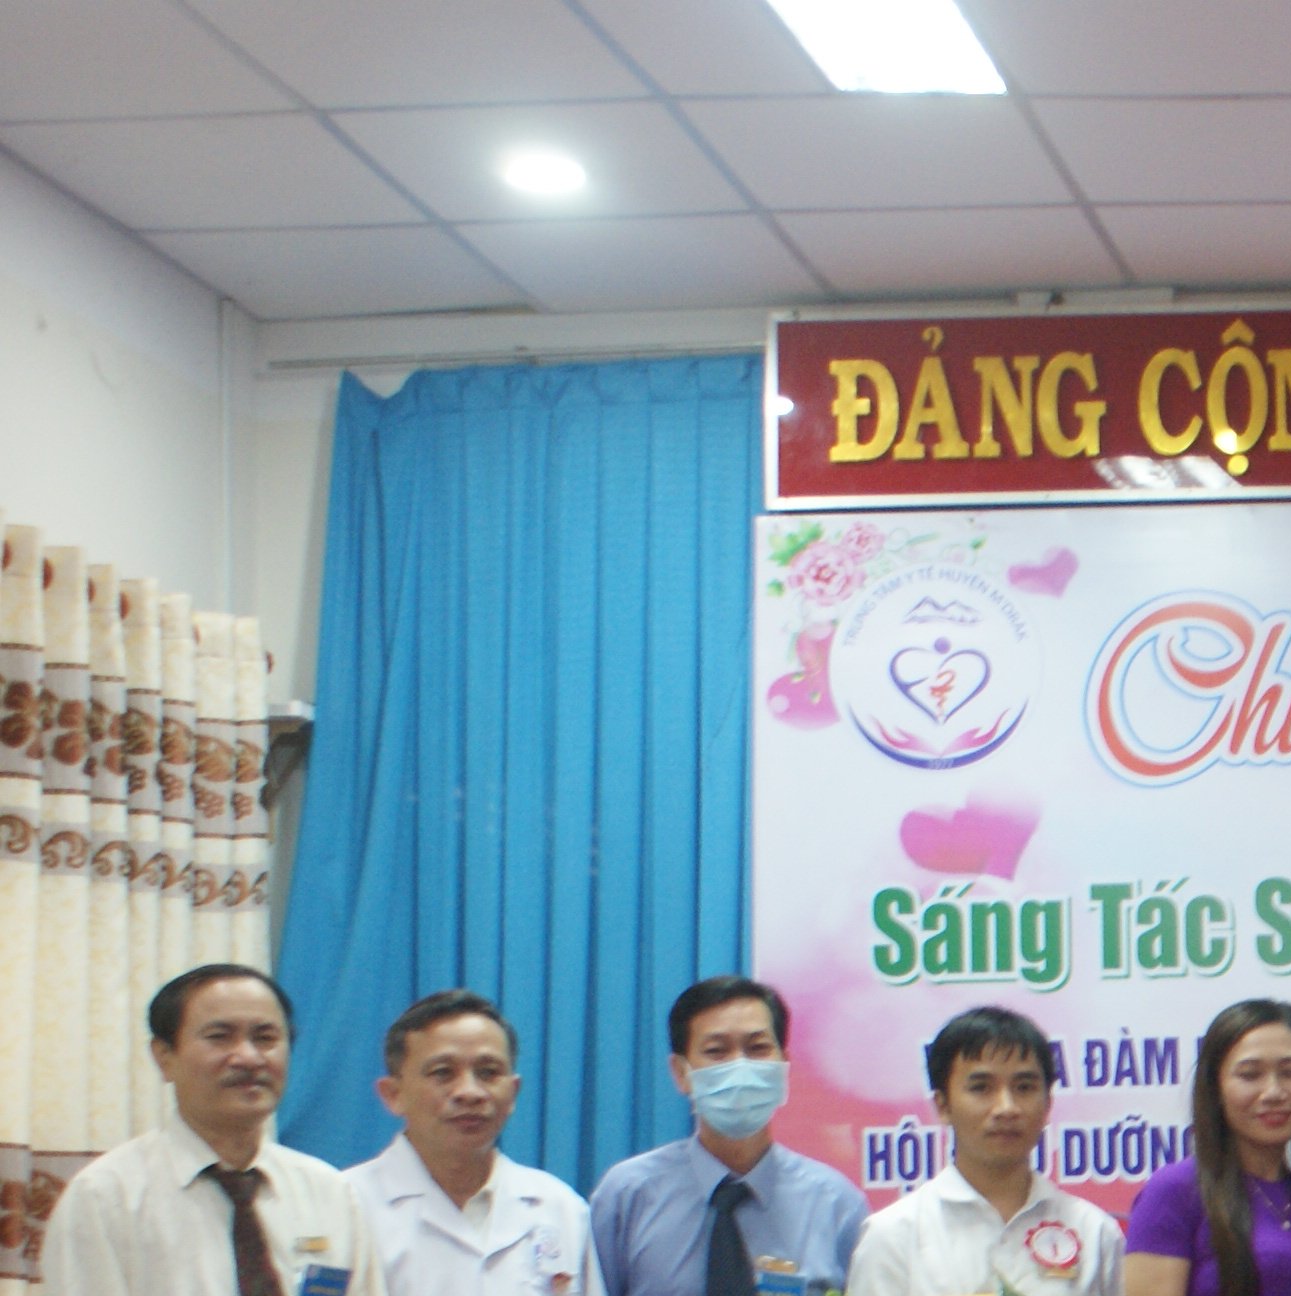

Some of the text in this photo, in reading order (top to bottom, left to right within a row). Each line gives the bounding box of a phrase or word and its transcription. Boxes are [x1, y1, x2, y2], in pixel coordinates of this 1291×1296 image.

[829, 326, 1106, 463] ĐẢNG
[1084, 1027, 1179, 1088] ĐÀM
[867, 1121, 937, 1193] HỘI
